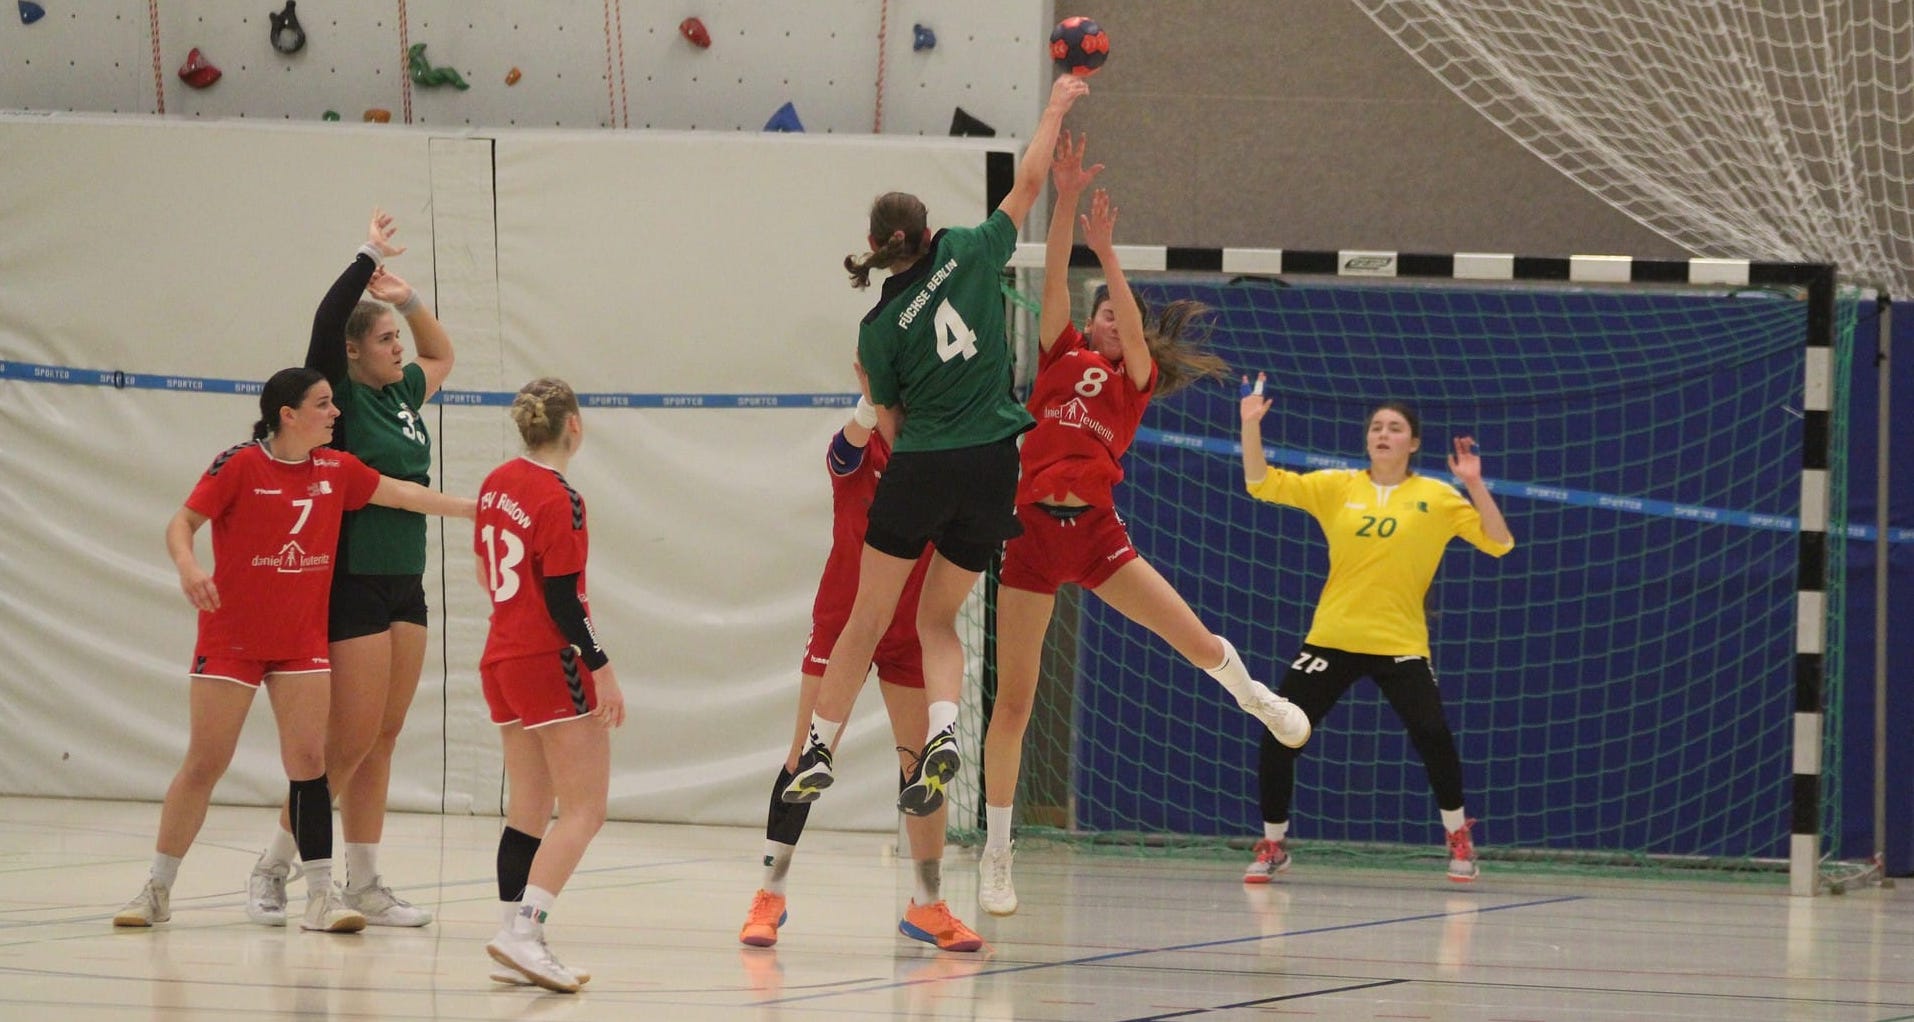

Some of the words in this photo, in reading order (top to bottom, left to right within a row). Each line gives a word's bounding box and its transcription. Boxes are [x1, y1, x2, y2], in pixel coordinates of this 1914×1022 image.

[898, 289, 931, 330] FÜCHSE
[926, 258, 958, 292] BERLIN
[934, 297, 978, 363] 4
[1074, 367, 1108, 397] 8
[289, 499, 313, 534] 7
[497, 493, 531, 529] Rudow
[1355, 515, 1397, 538] 20
[252, 555, 283, 567] daniel
[481, 524, 525, 602] 13
[1291, 652, 1329, 674] ZP
